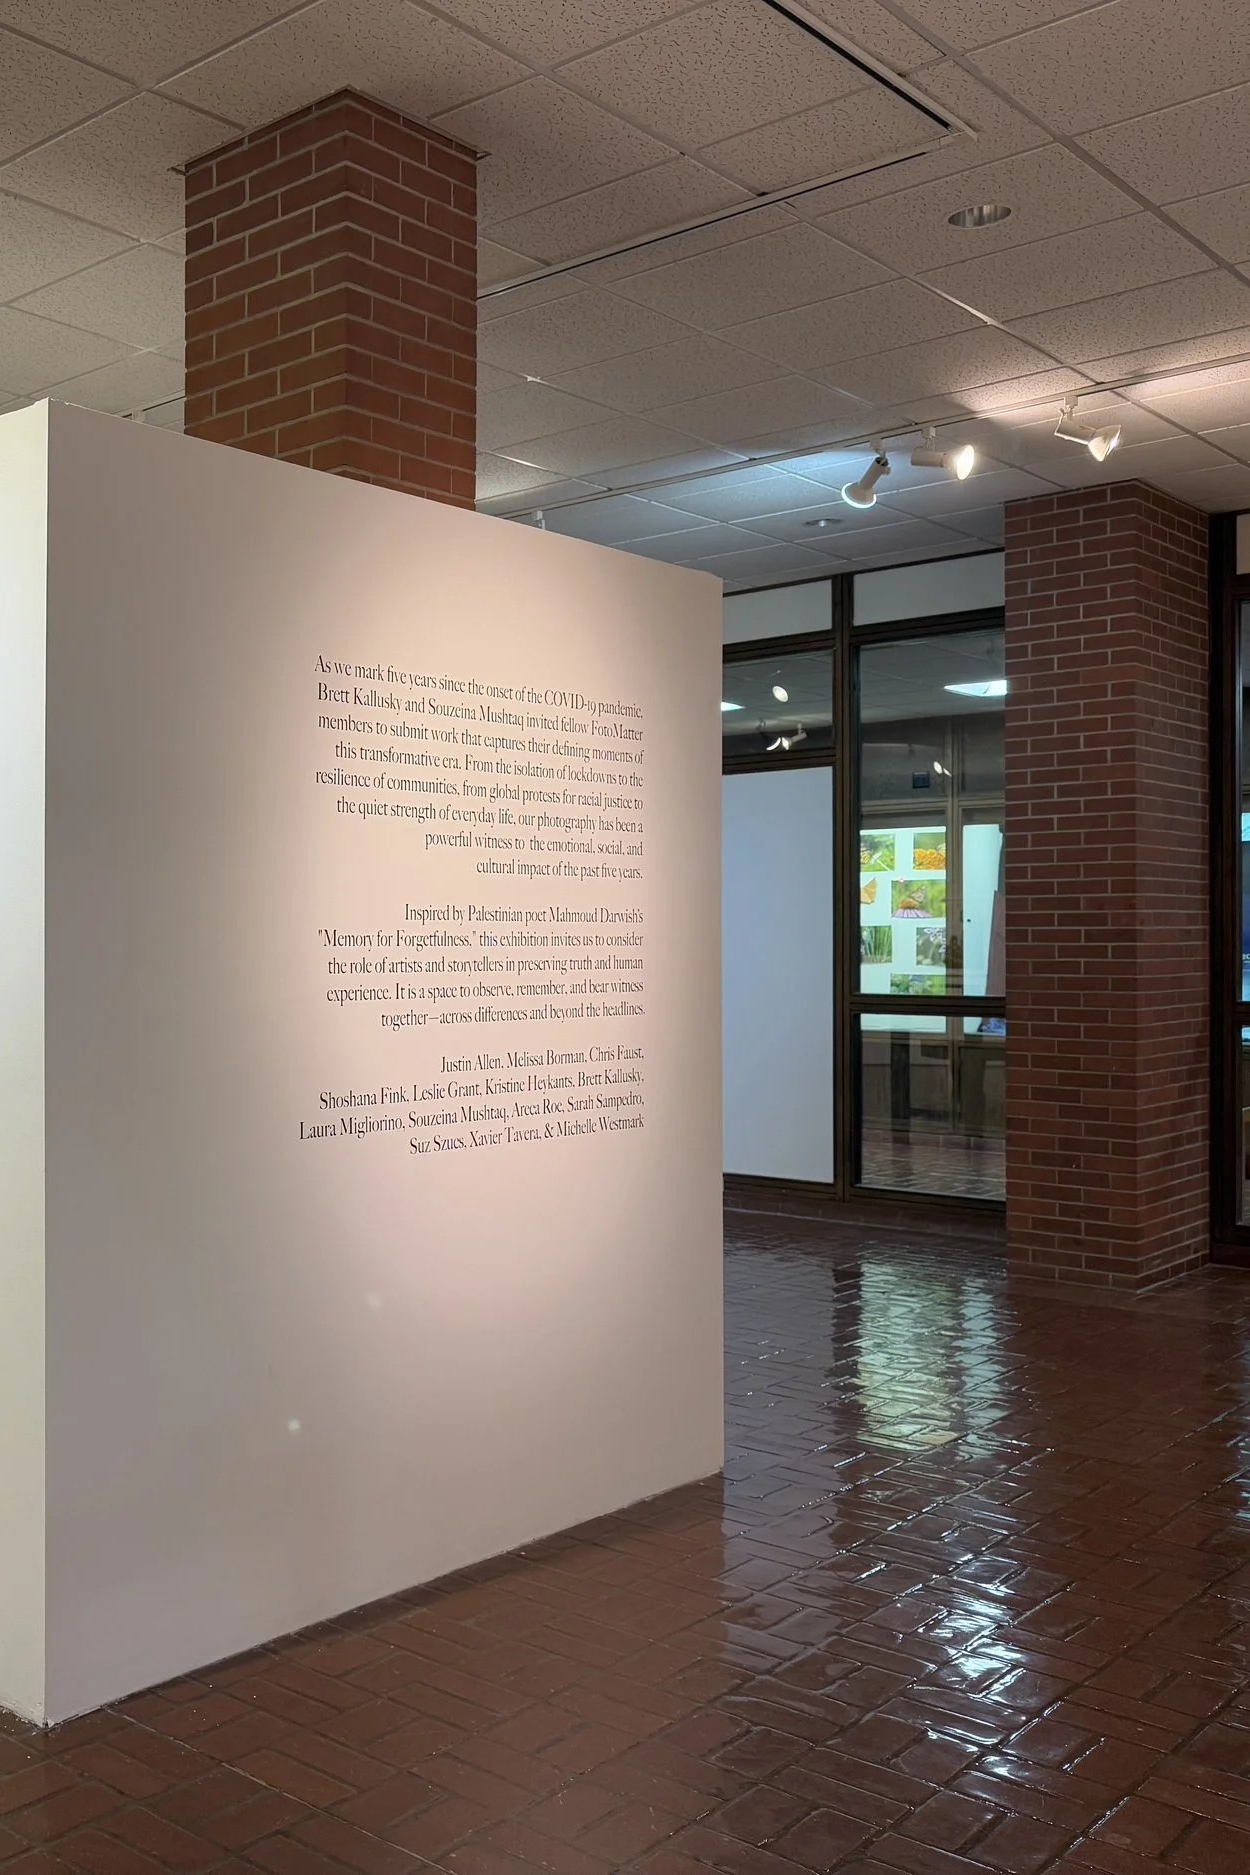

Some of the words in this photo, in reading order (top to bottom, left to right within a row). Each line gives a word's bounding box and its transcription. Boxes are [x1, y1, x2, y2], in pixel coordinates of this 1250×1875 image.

[314, 655, 331, 673] As
[334, 663, 351, 676] we
[354, 664, 384, 681] mark
[387, 665, 407, 684] five
[409, 674, 437, 690] years
[439, 675, 465, 692] since
[468, 679, 484, 695] the
[486, 686, 513, 700] onset
[515, 686, 527, 701] of
[527, 688, 542, 704] the
[544, 690, 596, 716] COVID-19
[318, 682, 350, 703] Brett
[353, 687, 402, 715] Kallusky
[404, 697, 425, 713] and
[428, 698, 476, 720] Souzeina
[479, 705, 524, 731] Mushtaq
[526, 712, 559, 730] invited
[561, 716, 589, 733] fellow
[591, 720, 643, 741] FotoMatter
[318, 715, 373, 733] members
[376, 722, 387, 735] to
[390, 721, 429, 740] submit
[431, 728, 459, 743] work
[461, 729, 482, 746] that
[484, 737, 526, 753] captures
[528, 737, 551, 754] their
[552, 740, 591, 763] defining
[592, 749, 633, 762] moments
[634, 750, 645, 764] of
[335, 741, 357, 759] this
[360, 746, 440, 767] transformative
[465, 754, 493, 772] From
[496, 758, 512, 774] the
[514, 760, 555, 778] isolation
[556, 765, 567, 779] of
[568, 766, 617, 784] lockdowns
[618, 774, 628, 785] to
[629, 772, 643, 787] the
[316, 768, 371, 787] resilience
[373, 772, 386, 788] of
[462, 780, 487, 797] from
[489, 783, 520, 803] global
[522, 790, 561, 805] protests
[562, 789, 577, 804] for
[578, 792, 602, 807] racial
[602, 793, 632, 811] justice
[634, 799, 643, 809] to
[337, 796, 356, 813] the
[358, 799, 388, 819] quiet
[390, 803, 436, 823] strength
[439, 804, 451, 820] of
[451, 807, 497, 828] everyday
[518, 815, 536, 826] our
[537, 812, 597, 834] photography
[599, 816, 614, 830] has
[615, 817, 637, 832] been
[638, 823, 643, 832] a
[425, 831, 472, 850] powerful
[475, 833, 513, 849] witness
[515, 838, 525, 849] to
[530, 835, 545, 851] the
[626, 842, 643, 855] and
[476, 858, 515, 874] cultural
[517, 860, 550, 879] impact
[552, 861, 563, 876] of
[564, 861, 579, 876] the
[580, 866, 600, 881] past
[601, 863, 617, 877] five
[405, 904, 450, 925] Inspired
[452, 905, 465, 926] by
[468, 905, 523, 922] Palestinian
[525, 911, 547, 926] poet
[549, 907, 598, 922] Mahmoud
[377, 930, 393, 946] for
[479, 931, 498, 946] this
[500, 931, 549, 946] exhibition
[551, 932, 581, 946] invites
[583, 936, 593, 946] us
[595, 936, 606, 946] to
[606, 931, 644, 946] consider
[328, 957, 347, 974] the
[350, 957, 372, 974] role
[374, 957, 388, 973] of
[388, 957, 422, 973] artists
[425, 956, 445, 972] and
[448, 956, 504, 976] storytellers
[505, 956, 515, 971] in
[517, 956, 567, 975] preserving
[569, 955, 592, 970] truth
[594, 955, 611, 969] and
[613, 955, 643, 969] human
[395, 983, 405, 999] It
[408, 984, 417, 999] is
[418, 988, 425, 998] a
[427, 987, 457, 1003] space
[460, 986, 470, 997] to
[569, 979, 587, 994] and
[589, 979, 609, 993] bear
[611, 979, 644, 992] witness
[475, 1006, 528, 1022] differences
[529, 1004, 548, 1019] and
[549, 1003, 584, 1023] beyond
[586, 1003, 600, 1017] the
[441, 1056, 472, 1072] Justin
[506, 1052, 544, 1068] Melissa
[589, 1047, 615, 1062] Chris
[319, 1090, 377, 1109] Shoshana
[413, 1084, 446, 1101] Leslie
[485, 1078, 525, 1094] Kristine
[578, 1072, 602, 1087] Brett
[299, 1122, 337, 1139] Laura
[408, 1109, 458, 1127] Souzeina
[567, 1095, 594, 1112] Sarah
[409, 1137, 431, 1154] Suz
[469, 1130, 502, 1147] Xavier
[544, 1123, 554, 1138] &
[556, 1119, 597, 1137] Michelle
[599, 1113, 645, 1130] Westmark
